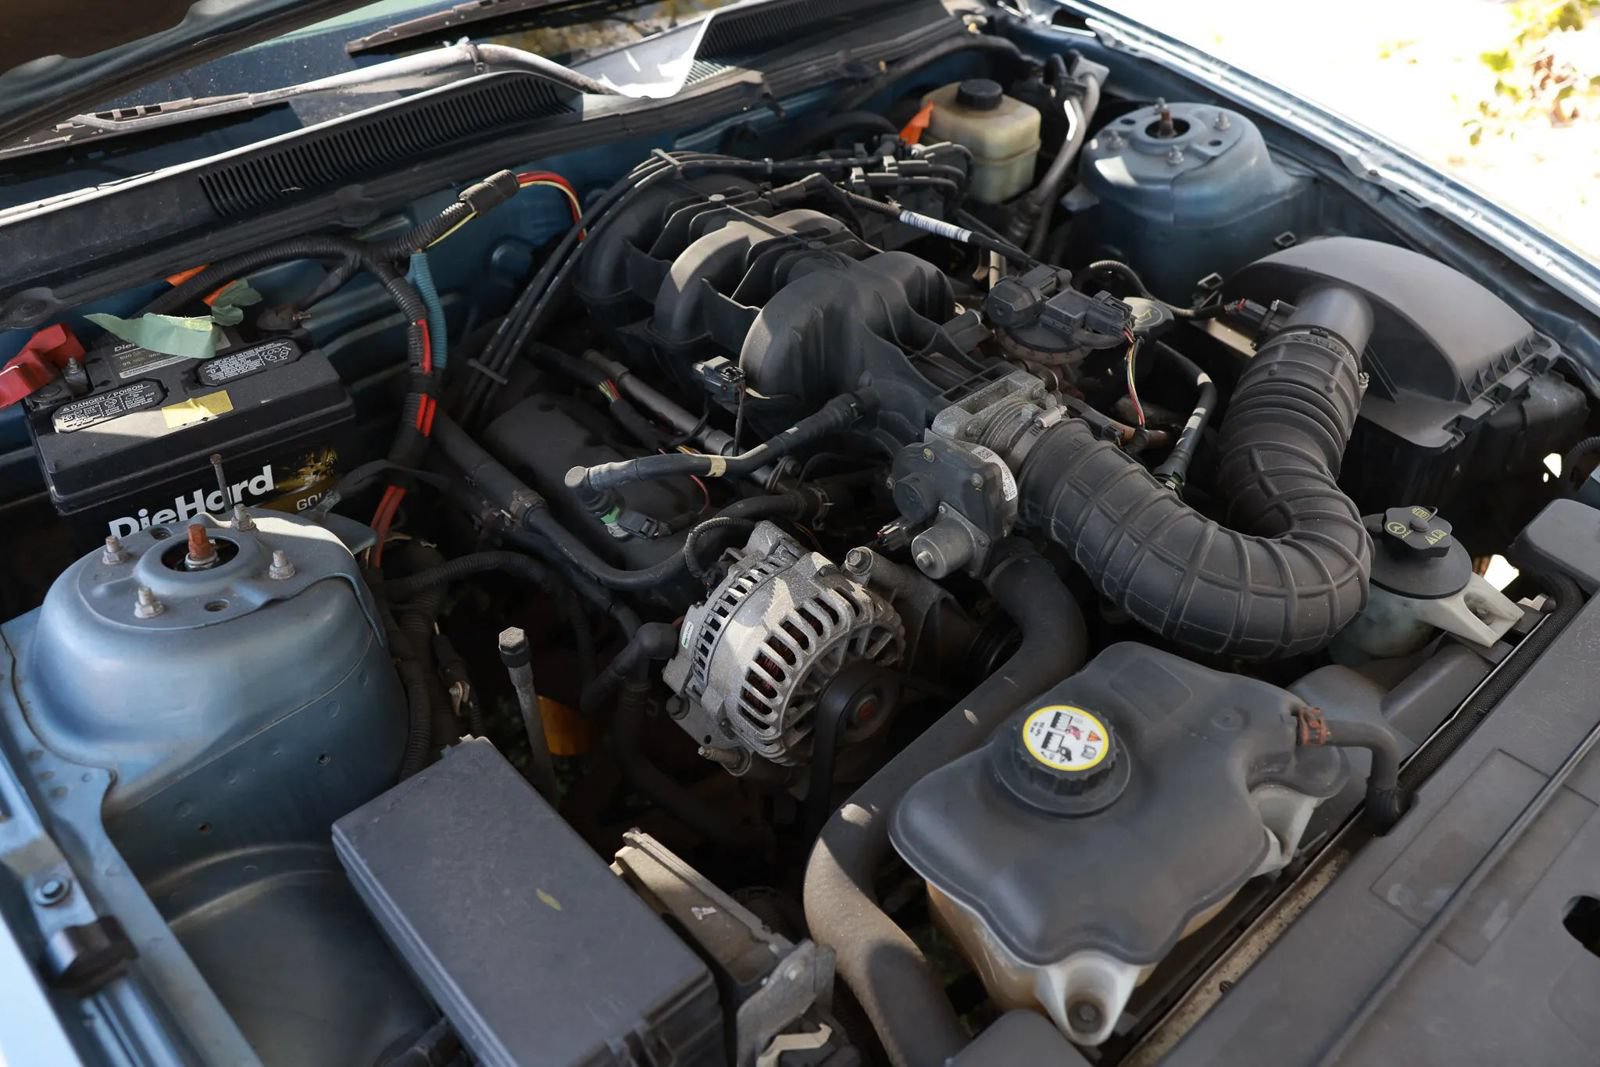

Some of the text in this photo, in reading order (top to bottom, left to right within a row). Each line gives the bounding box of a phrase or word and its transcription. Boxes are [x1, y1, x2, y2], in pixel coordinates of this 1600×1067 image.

[72, 397, 105, 410] DANGER
[113, 384, 144, 397] POISON
[108, 464, 274, 540] DieHard
[296, 492, 322, 511] GO
